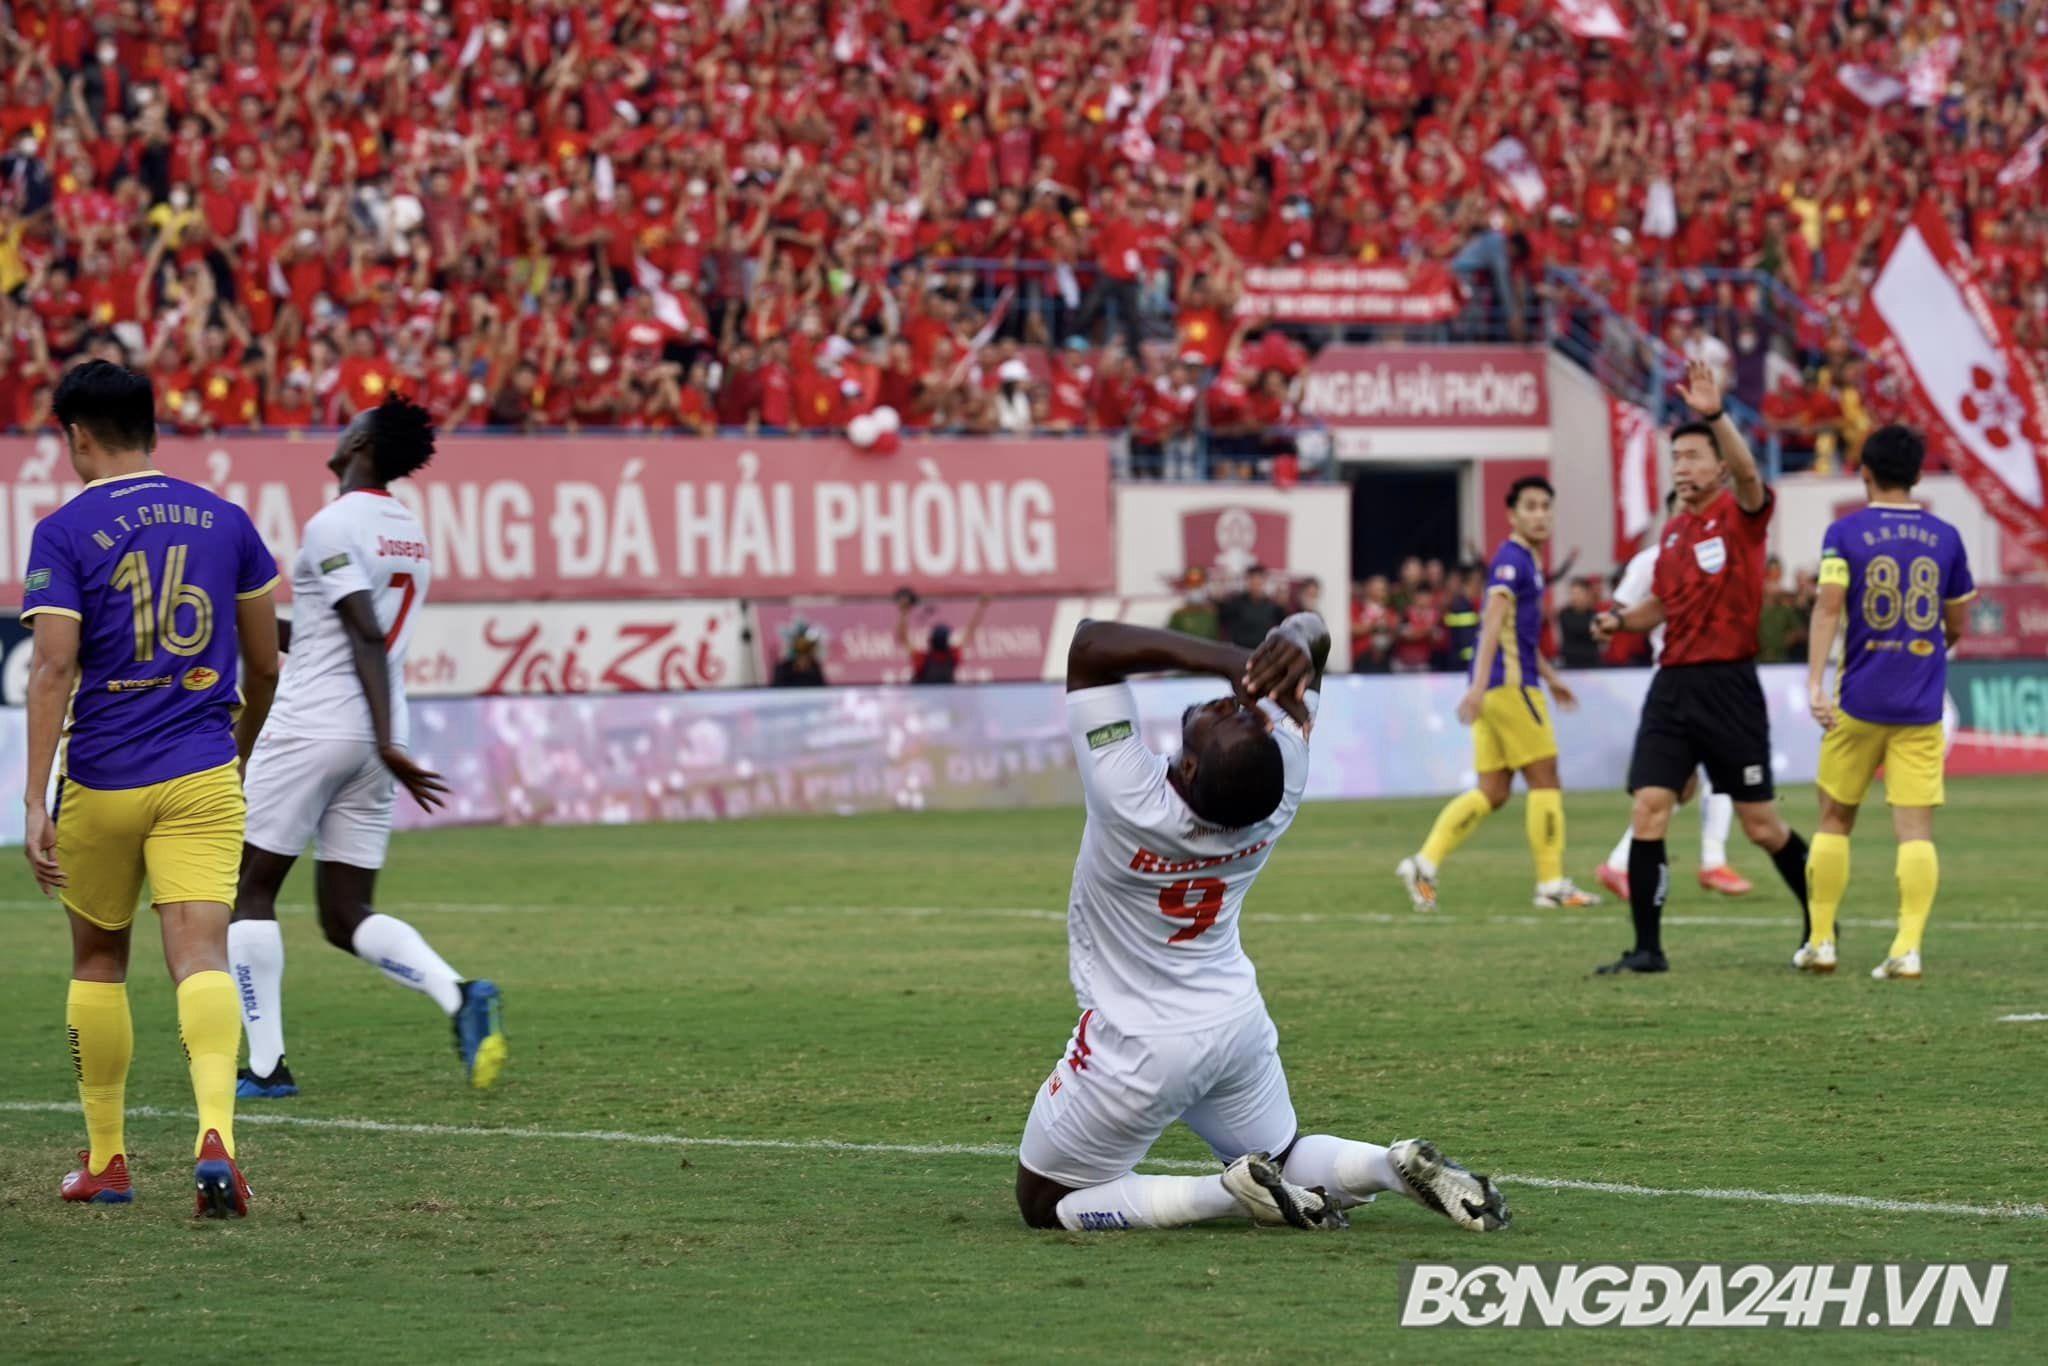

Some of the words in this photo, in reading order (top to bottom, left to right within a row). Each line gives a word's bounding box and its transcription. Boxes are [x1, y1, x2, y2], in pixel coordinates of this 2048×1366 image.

[1301, 371, 1351, 416] NG
[1446, 361, 1538, 416] PHÒNG
[92, 503, 214, 550] N.T.CHUNG
[549, 457, 660, 578] ĐÁ
[674, 451, 795, 577] HẢI
[813, 457, 1057, 577] PHÒNG
[109, 544, 214, 662] 16
[388, 572, 416, 655] 7
[1863, 555, 1940, 632] 88
[1158, 878, 1227, 945] 9
